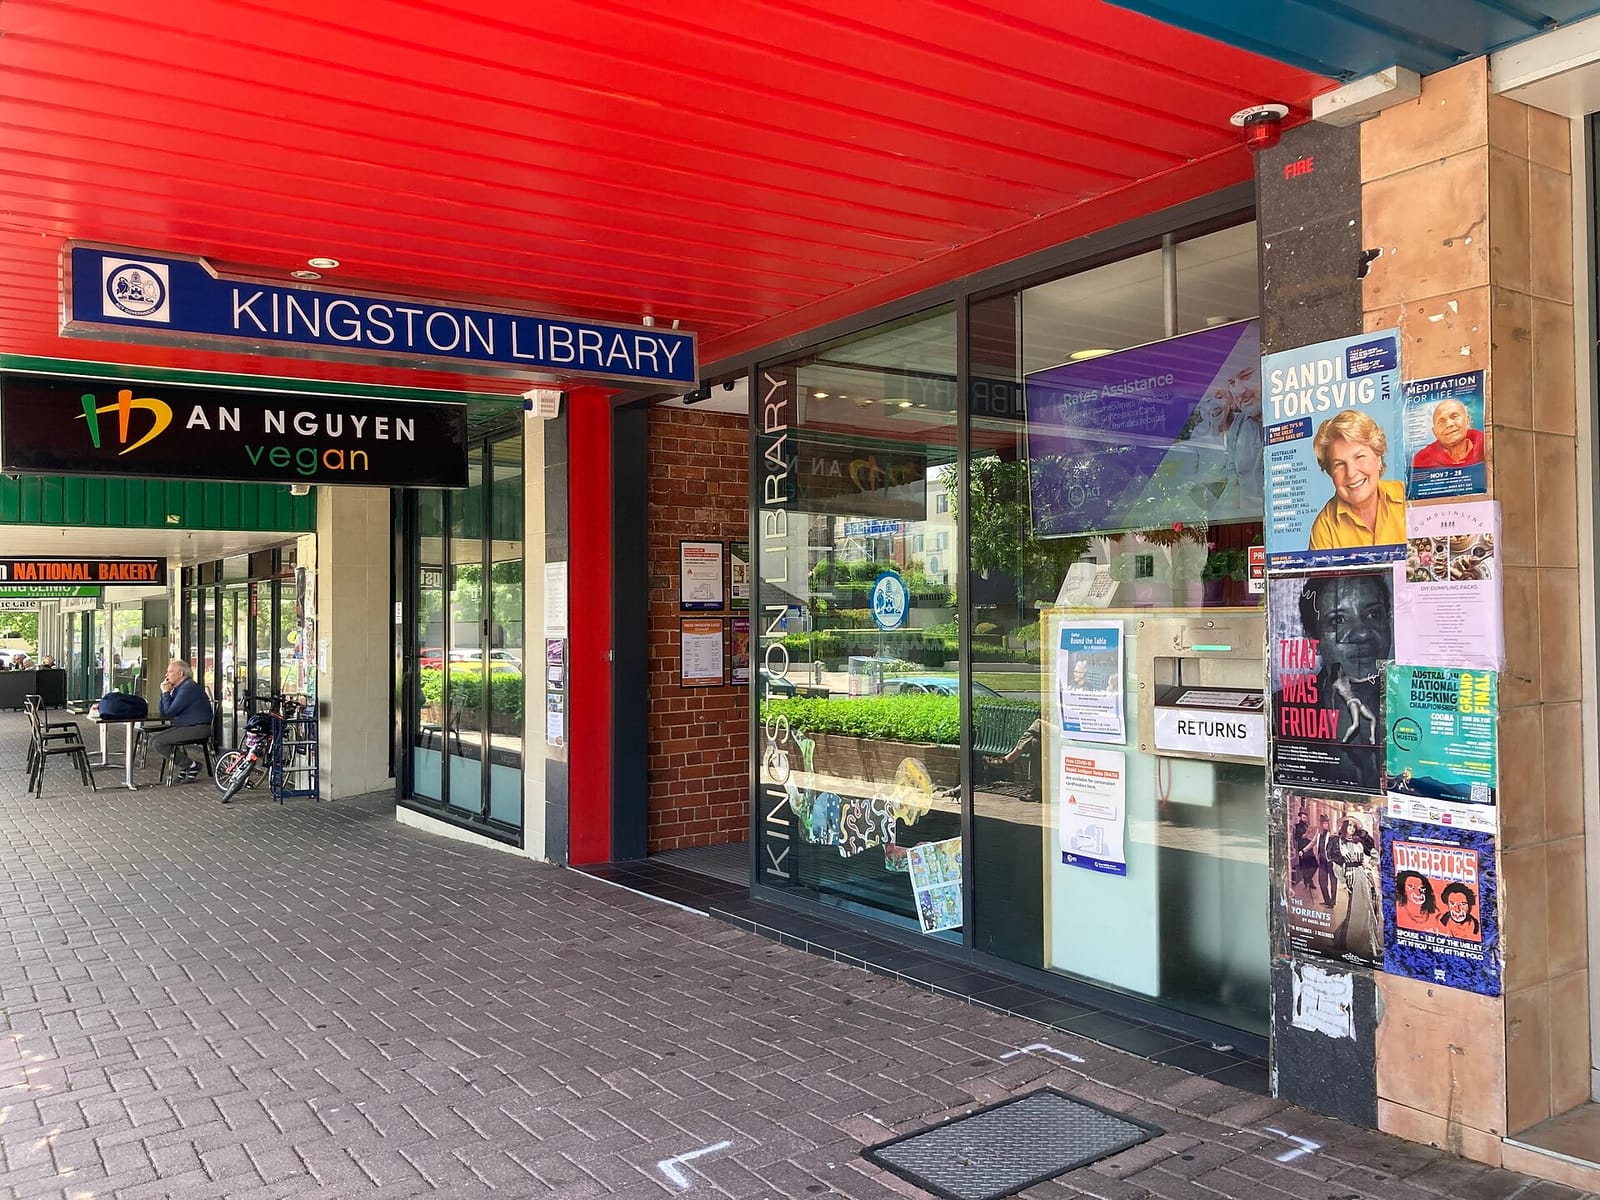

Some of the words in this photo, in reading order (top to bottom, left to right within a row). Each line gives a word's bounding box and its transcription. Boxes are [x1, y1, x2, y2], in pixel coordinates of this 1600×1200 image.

[1284, 157, 1314, 180] FIRE
[232, 288, 495, 356] KINGSTON
[510, 320, 684, 374] LIBRARY
[1063, 390, 1098, 406] Rates
[1100, 373, 1174, 399] Assistance
[1271, 356, 1342, 395] SANDI
[1380, 374, 1391, 401] LIVE
[1407, 376, 1475, 395] MEDITATION
[1271, 378, 1375, 420] TOKSVIG
[1408, 395, 1427, 405] FOR
[1430, 390, 1453, 401] LIFE
[186, 405, 241, 434] AN
[264, 409, 415, 441] NGUYEN
[244, 444, 369, 476] vegan
[764, 372, 788, 583] LIBRARY
[13, 563, 92, 580] NATIONAL
[99, 563, 158, 580] BAKERY
[1280, 639, 1319, 669] THAT
[1280, 673, 1318, 704] WAS
[1411, 679, 1458, 691] NATIONAL
[1411, 691, 1457, 704] BUSKING
[1460, 672, 1473, 714] GRAND
[1474, 674, 1490, 714] FINAL
[1410, 702, 1458, 711] CHAMPIONSHIPS
[1431, 713, 1454, 721] COOMA
[1178, 720, 1247, 739] RETURNS
[1281, 708, 1340, 740] FRIDAY
[764, 605, 790, 879] KINGSTON
[1395, 844, 1476, 884] DEBBIES
[1291, 898, 1303, 906] THE
[1291, 906, 1331, 921] TORRENTS
